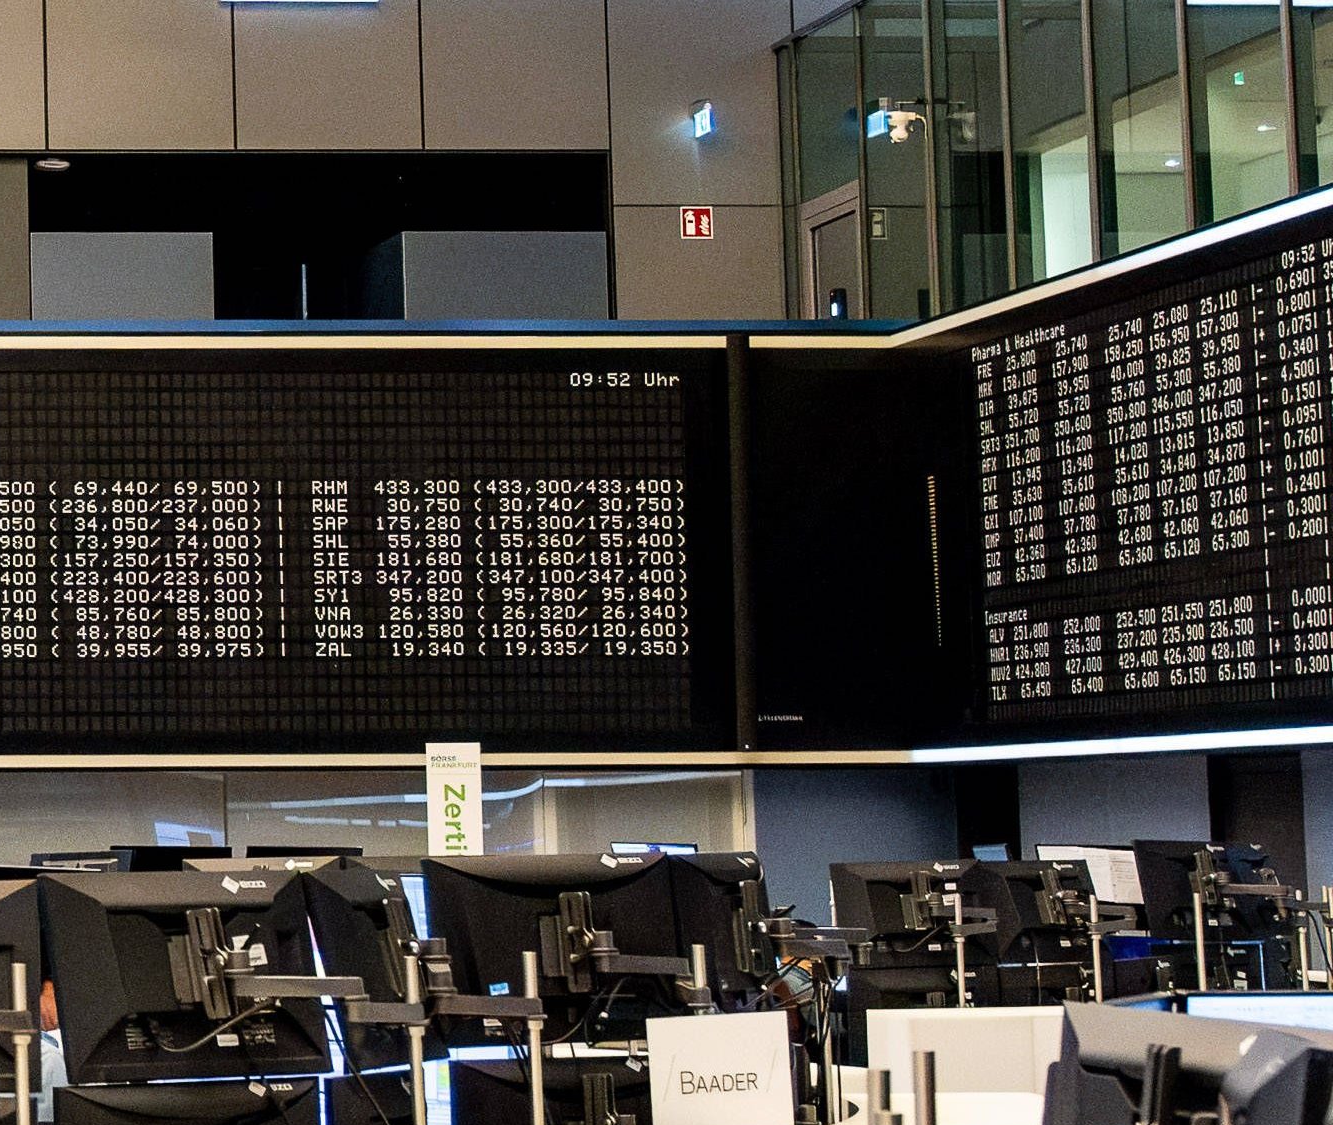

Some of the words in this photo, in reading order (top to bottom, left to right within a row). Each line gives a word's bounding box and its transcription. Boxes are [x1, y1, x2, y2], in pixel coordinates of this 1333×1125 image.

[1282, 244, 1315, 269] 09:52
[1197, 312, 1238, 338] 157,300
[972, 344, 1001, 362] Pharma
[1015, 325, 1065, 350] Healthcare
[978, 362, 992, 380] FRE
[1055, 334, 1087, 357] 25,740
[1108, 318, 1142, 343] 25,740
[1200, 290, 1237, 315] 25,110
[1202, 334, 1239, 358] 39,950
[1204, 355, 1241, 379] 55,380
[570, 372, 631, 387] 09:52
[644, 372, 680, 387] Uhr
[311, 480, 348, 495] RHM
[374, 479, 460, 495] 433,300
[312, 516, 349, 531] SAP
[376, 515, 461, 531] 175,280
[313, 552, 350, 567] SIE
[377, 551, 462, 567] 181,680
[313, 570, 363, 585] SRT3
[376, 569, 462, 585] 347,200
[985, 609, 1027, 626] Insurance
[315, 624, 364, 639] VOW3
[379, 623, 464, 639] 120,580
[1014, 622, 1048, 641] 251,800
[315, 642, 352, 657] ZAL
[392, 641, 465, 657] 19,340
[992, 686, 1006, 700] TLX
[1021, 682, 1051, 698] 65,450
[1072, 676, 1103, 694] 65,400
[1171, 666, 1206, 685] 65,150
[1218, 662, 1256, 681] 65,150
[444, 784, 468, 850] Zerti
